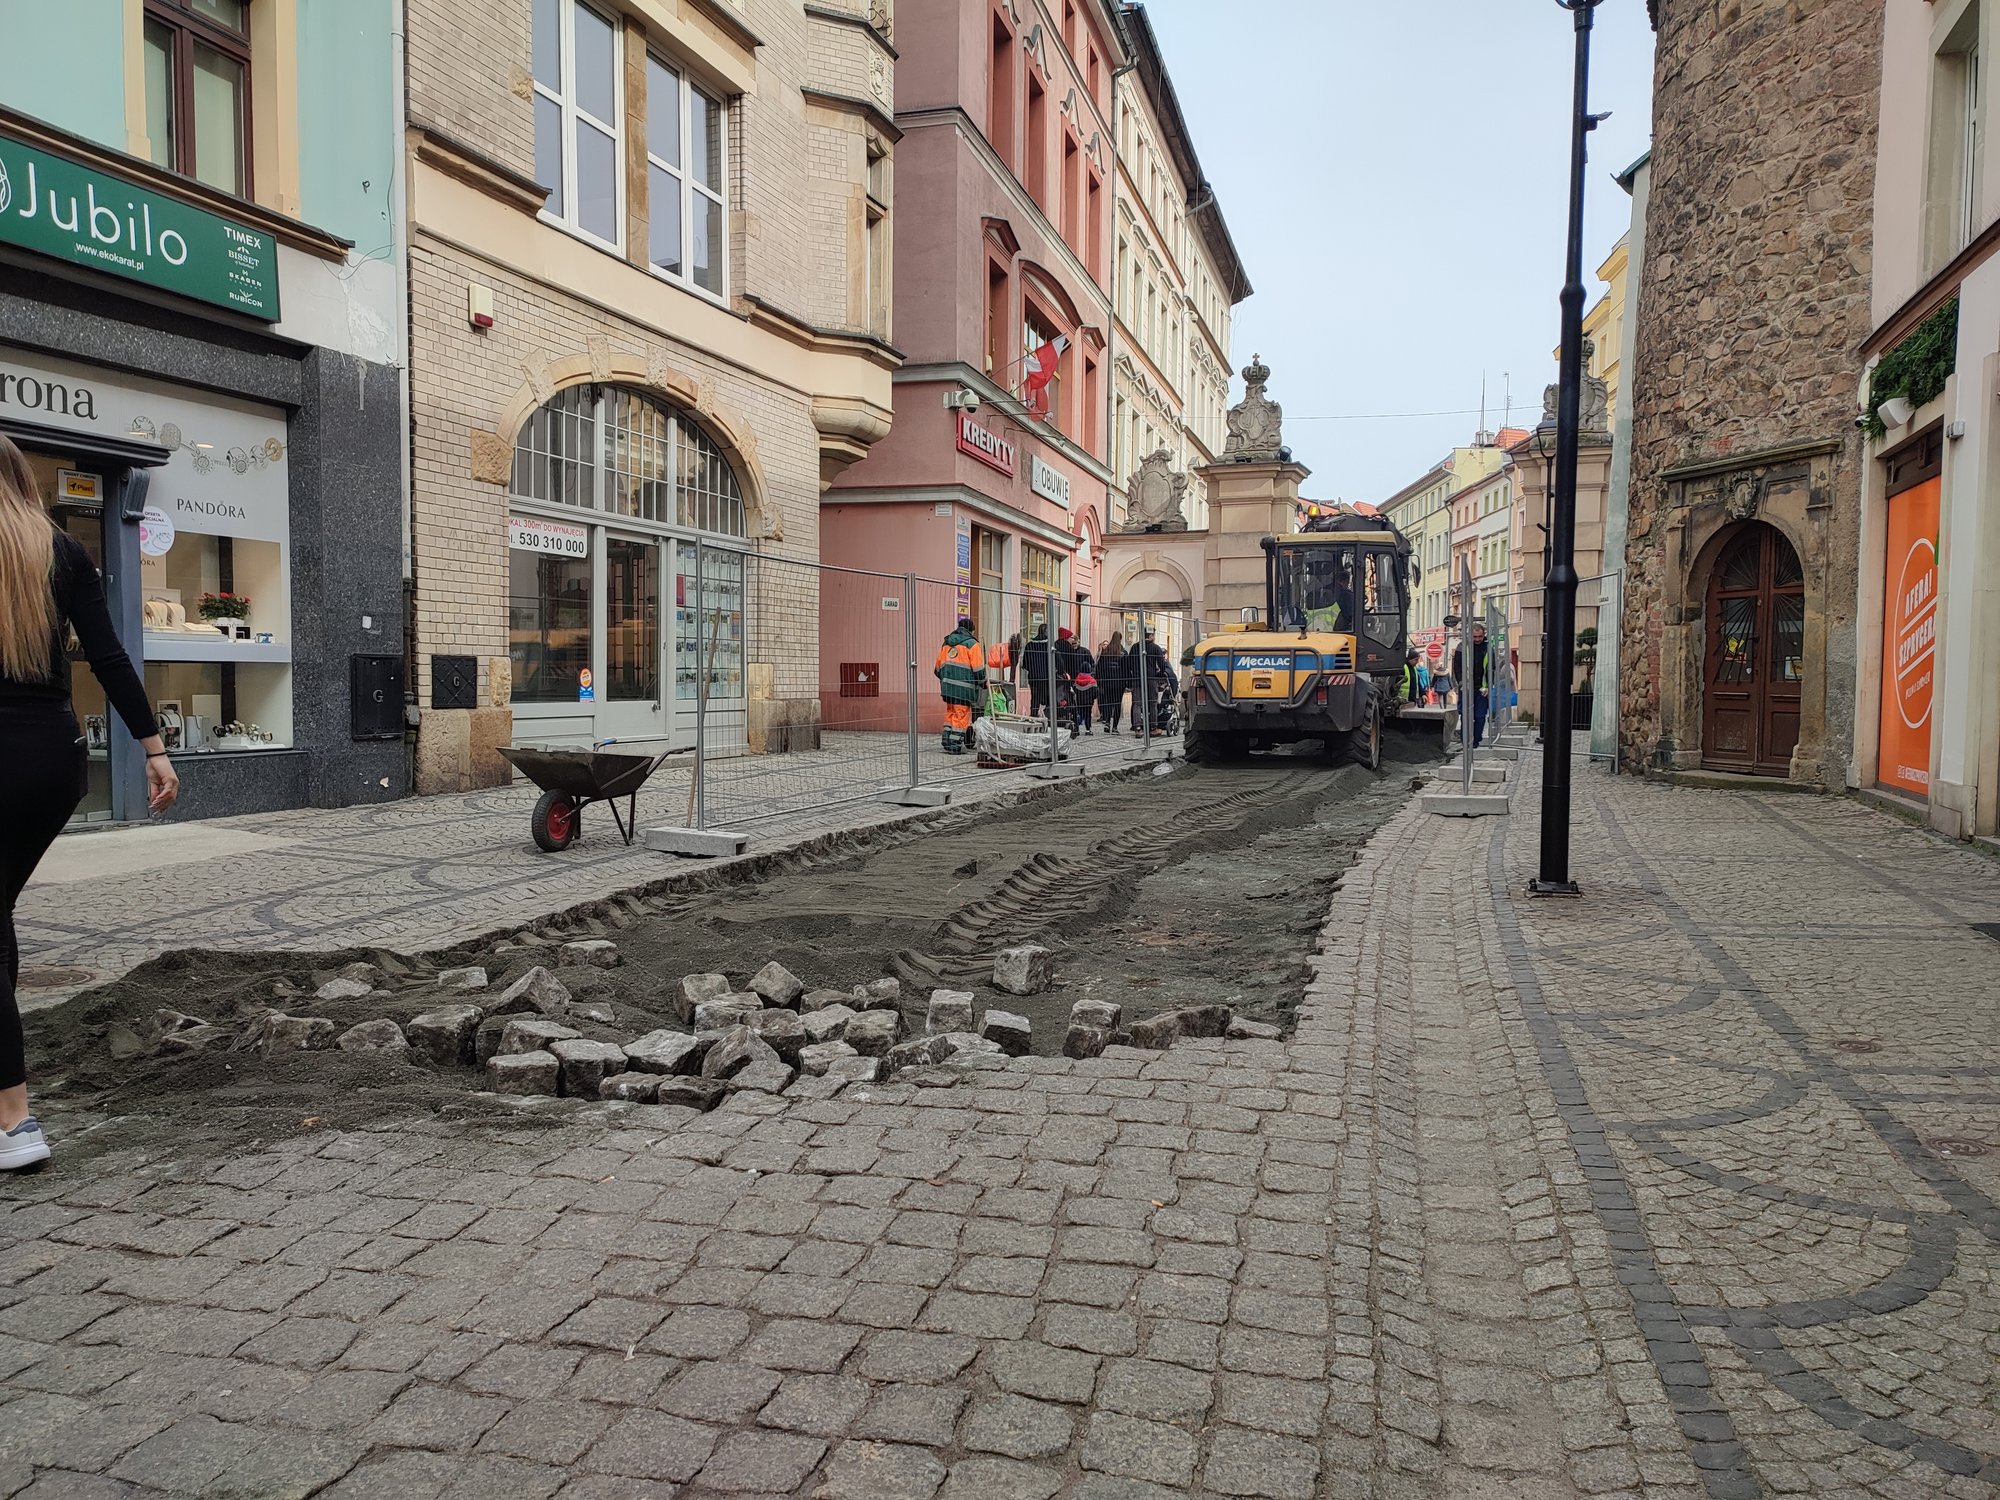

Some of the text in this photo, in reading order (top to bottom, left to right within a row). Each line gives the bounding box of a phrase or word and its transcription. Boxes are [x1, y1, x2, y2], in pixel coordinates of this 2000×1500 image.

[19, 162, 187, 266] Jubilo
[223, 226, 261, 250] TIMEX
[75, 243, 144, 271] www.ekokarat.pl
[228, 249, 260, 267] BISSET
[229, 291, 263, 308] RUBICON
[963, 416, 1014, 466] KREDYTY
[1041, 466, 1069, 501] OBUWIE
[543, 523, 552, 532] DO
[519, 532, 540, 547] 530
[543, 535, 563, 551] 310
[565, 539, 585, 554] 000
[1904, 569, 1933, 619] AFERA!
[453, 676, 460, 687] G
[372, 689, 384, 703] G
